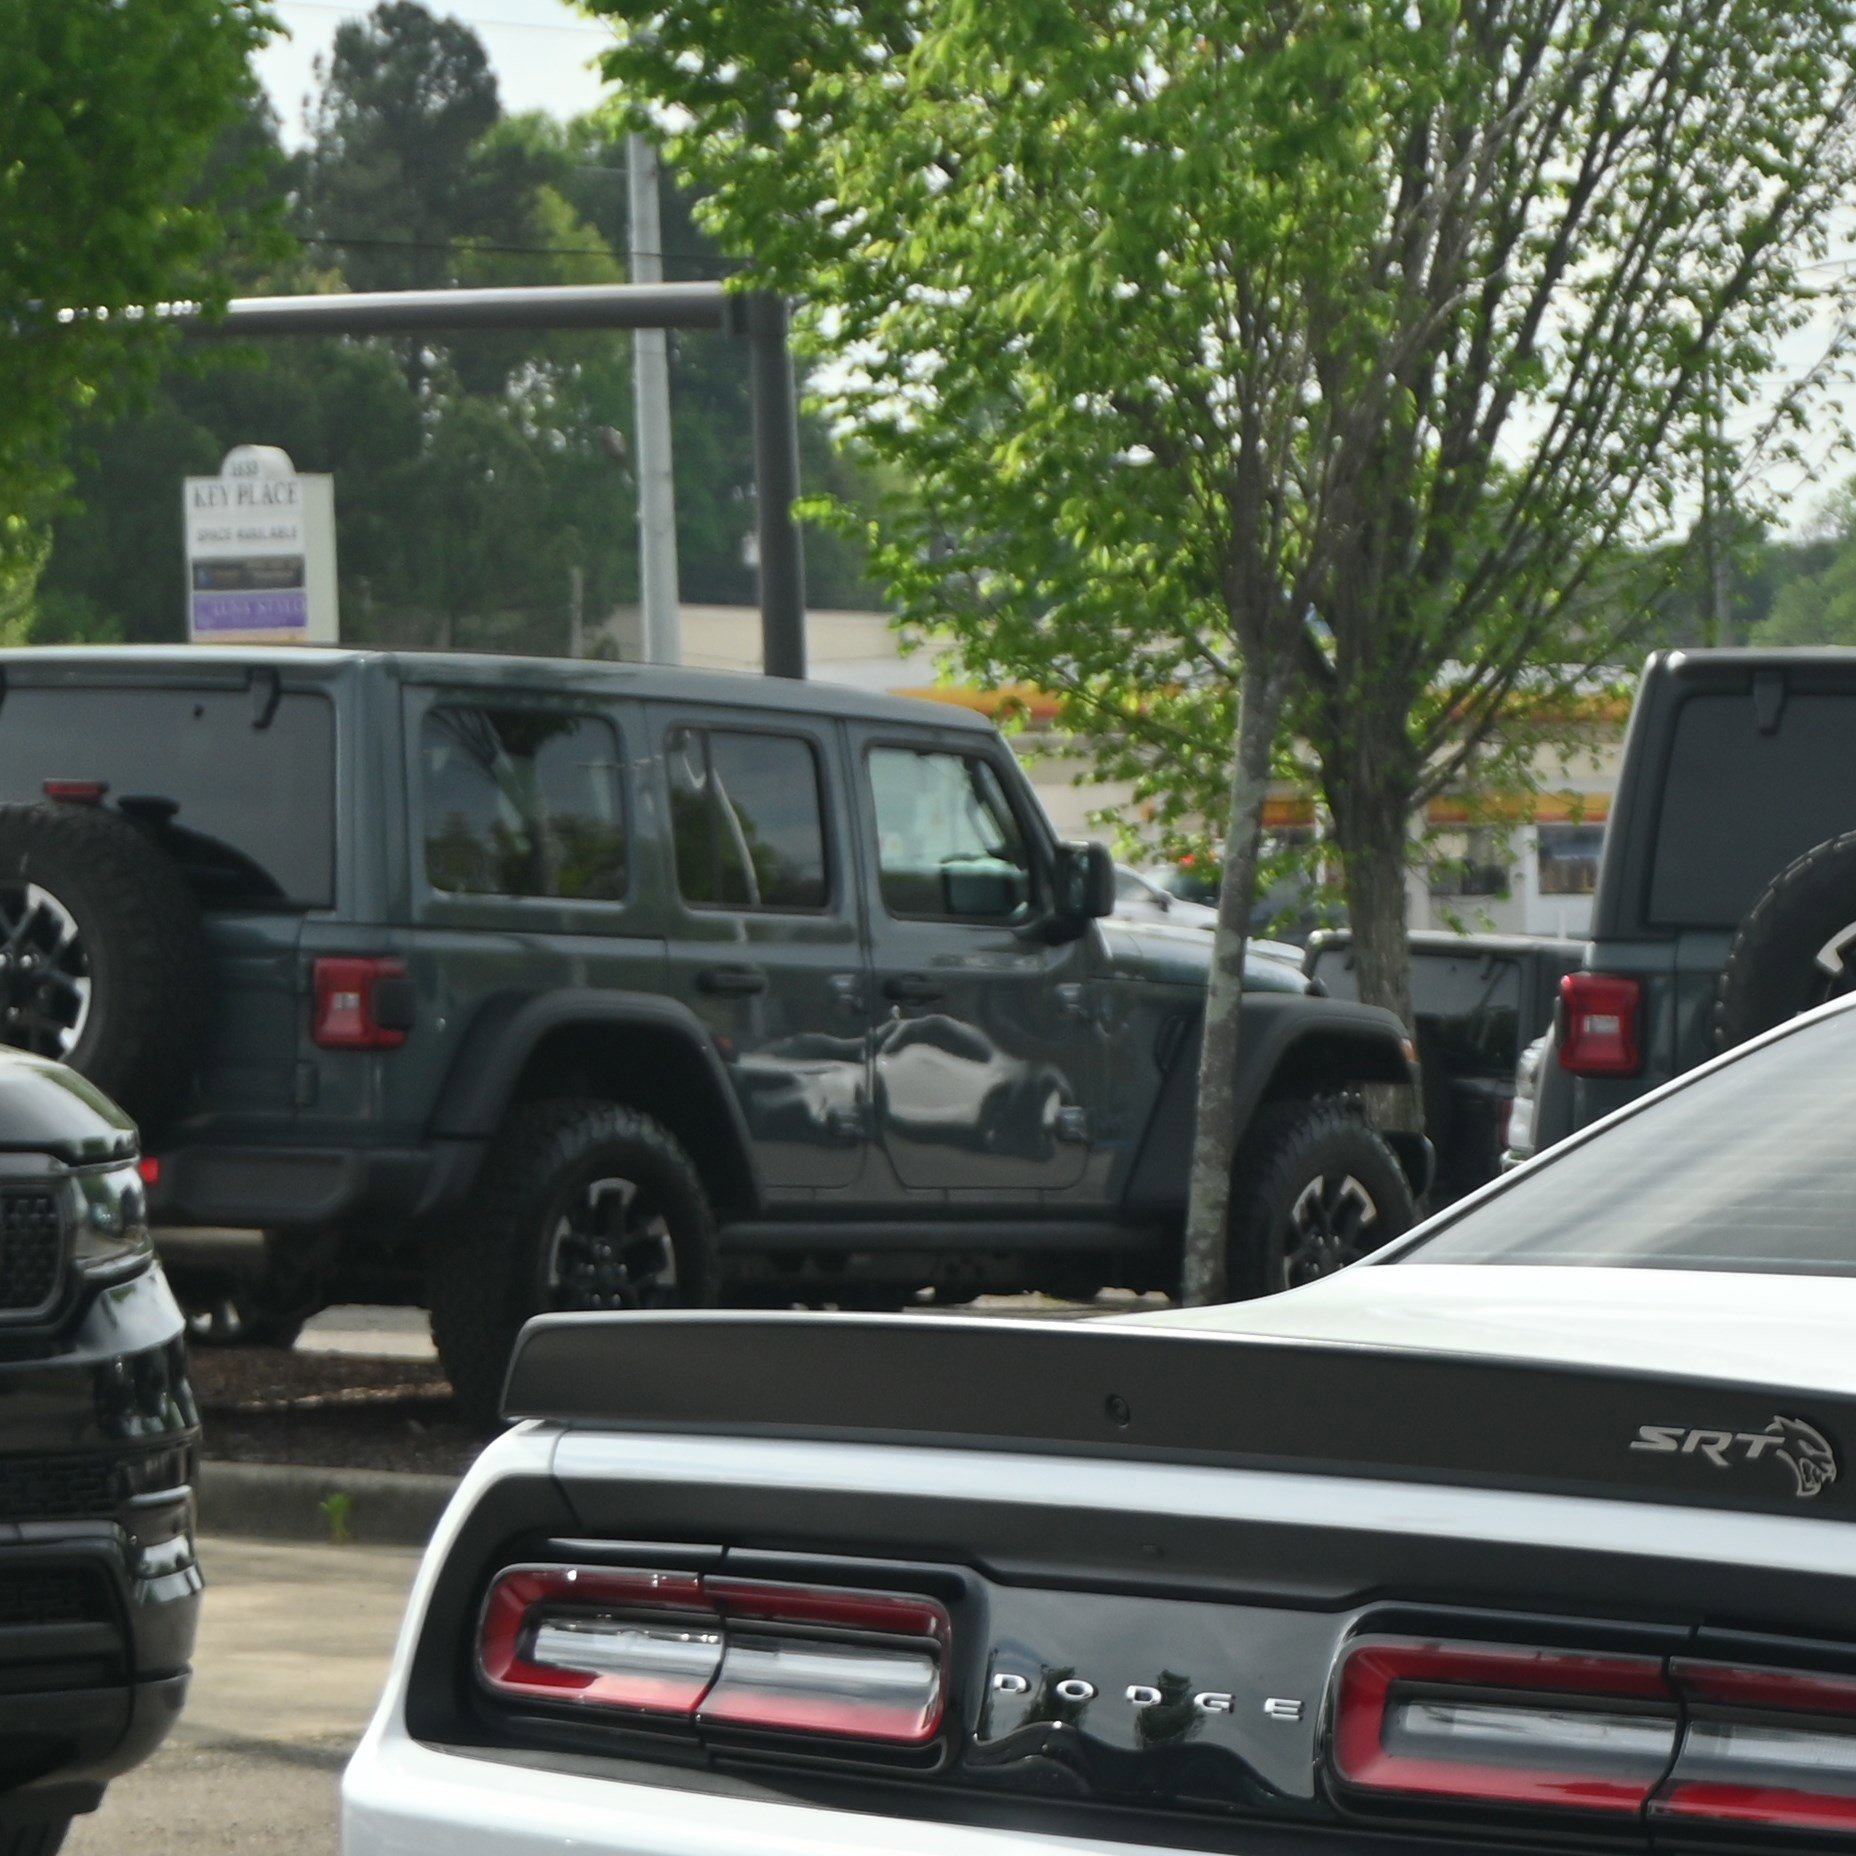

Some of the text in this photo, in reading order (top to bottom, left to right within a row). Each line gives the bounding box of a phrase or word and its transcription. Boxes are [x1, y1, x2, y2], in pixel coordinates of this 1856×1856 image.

[194, 481, 299, 507] KEY PLACE
[1629, 1425, 1786, 1467] SRT
[992, 1672, 1305, 1722] DODGE
